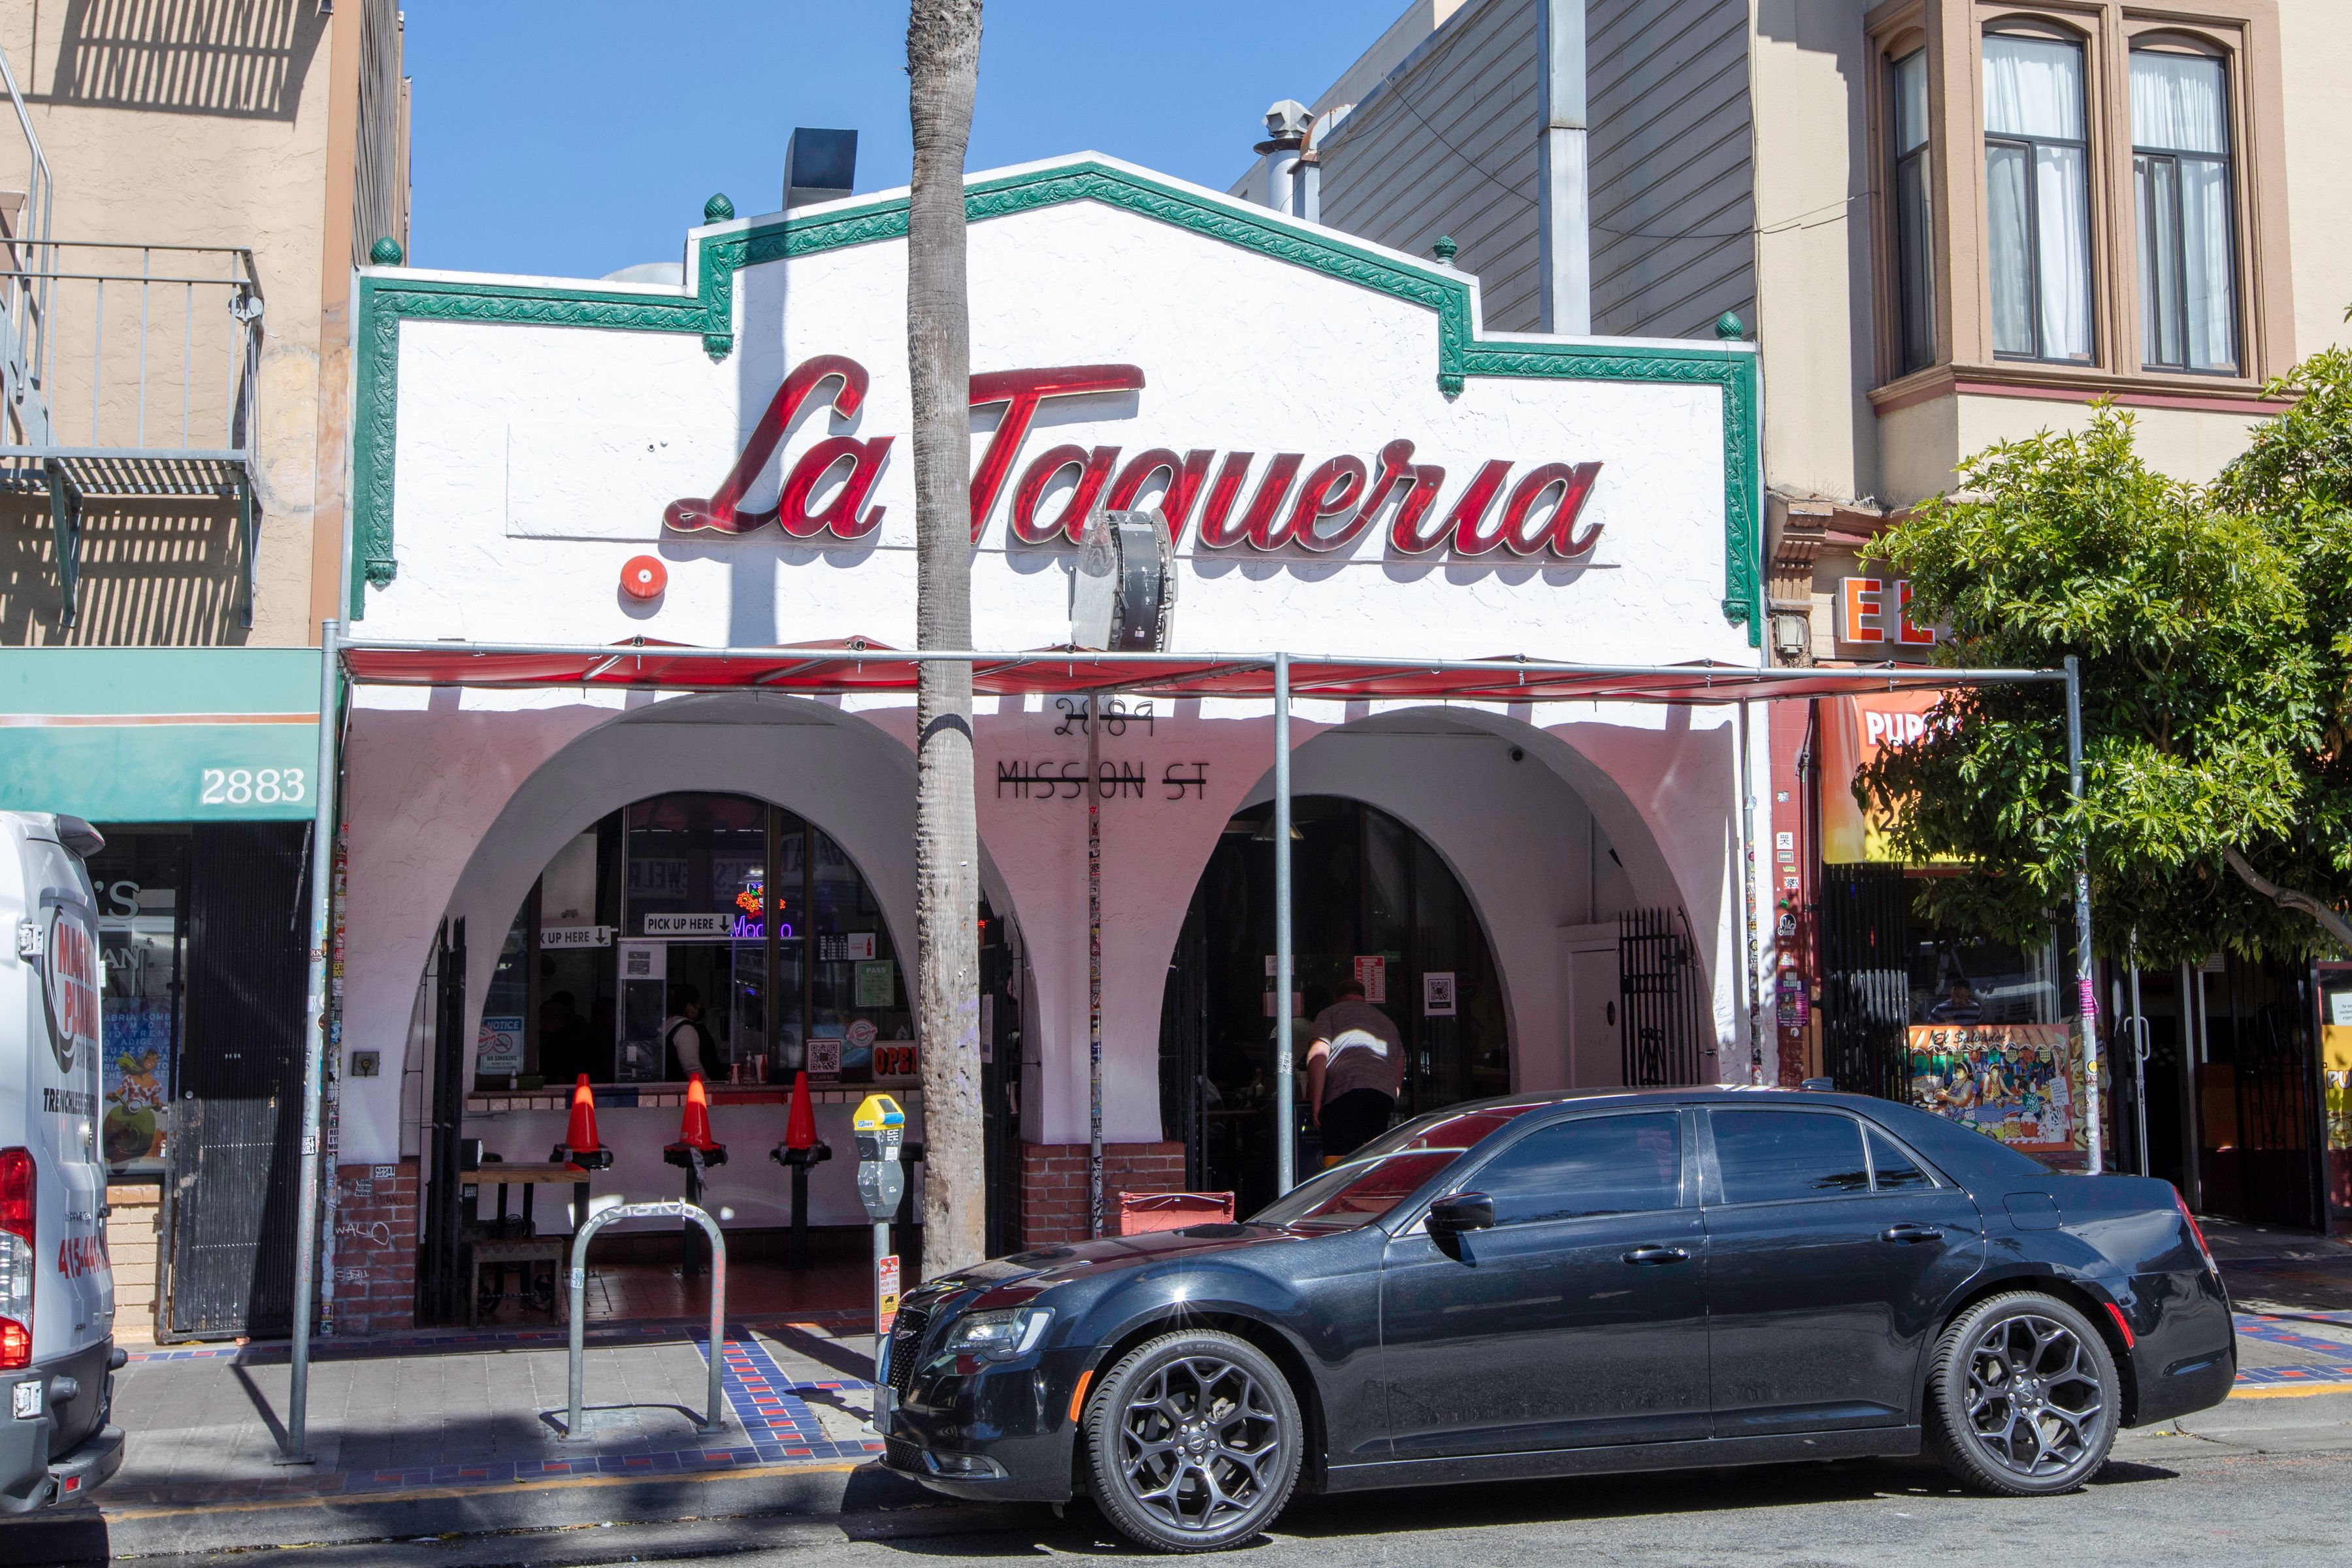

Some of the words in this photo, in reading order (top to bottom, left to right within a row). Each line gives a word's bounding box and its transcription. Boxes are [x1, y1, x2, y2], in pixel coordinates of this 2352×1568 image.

[663, 355, 894, 539] La
[970, 364, 1606, 557] Taqueria
[1054, 697, 1154, 736] 2889
[203, 768, 305, 804] 2883
[998, 761, 1143, 798] MISSON
[1166, 763, 1209, 799] ST
[648, 919, 671, 930] PICK
[674, 919, 686, 930] UP
[690, 918, 713, 929] HERE
[548, 933, 562, 943] UP
[565, 932, 589, 943] HERE
[487, 1021, 519, 1030] NOTICE
[1933, 1030, 1950, 1045] El
[2327, 1070, 2352, 1090] PU
[44, 1088, 84, 1115] TRENCHLESS
